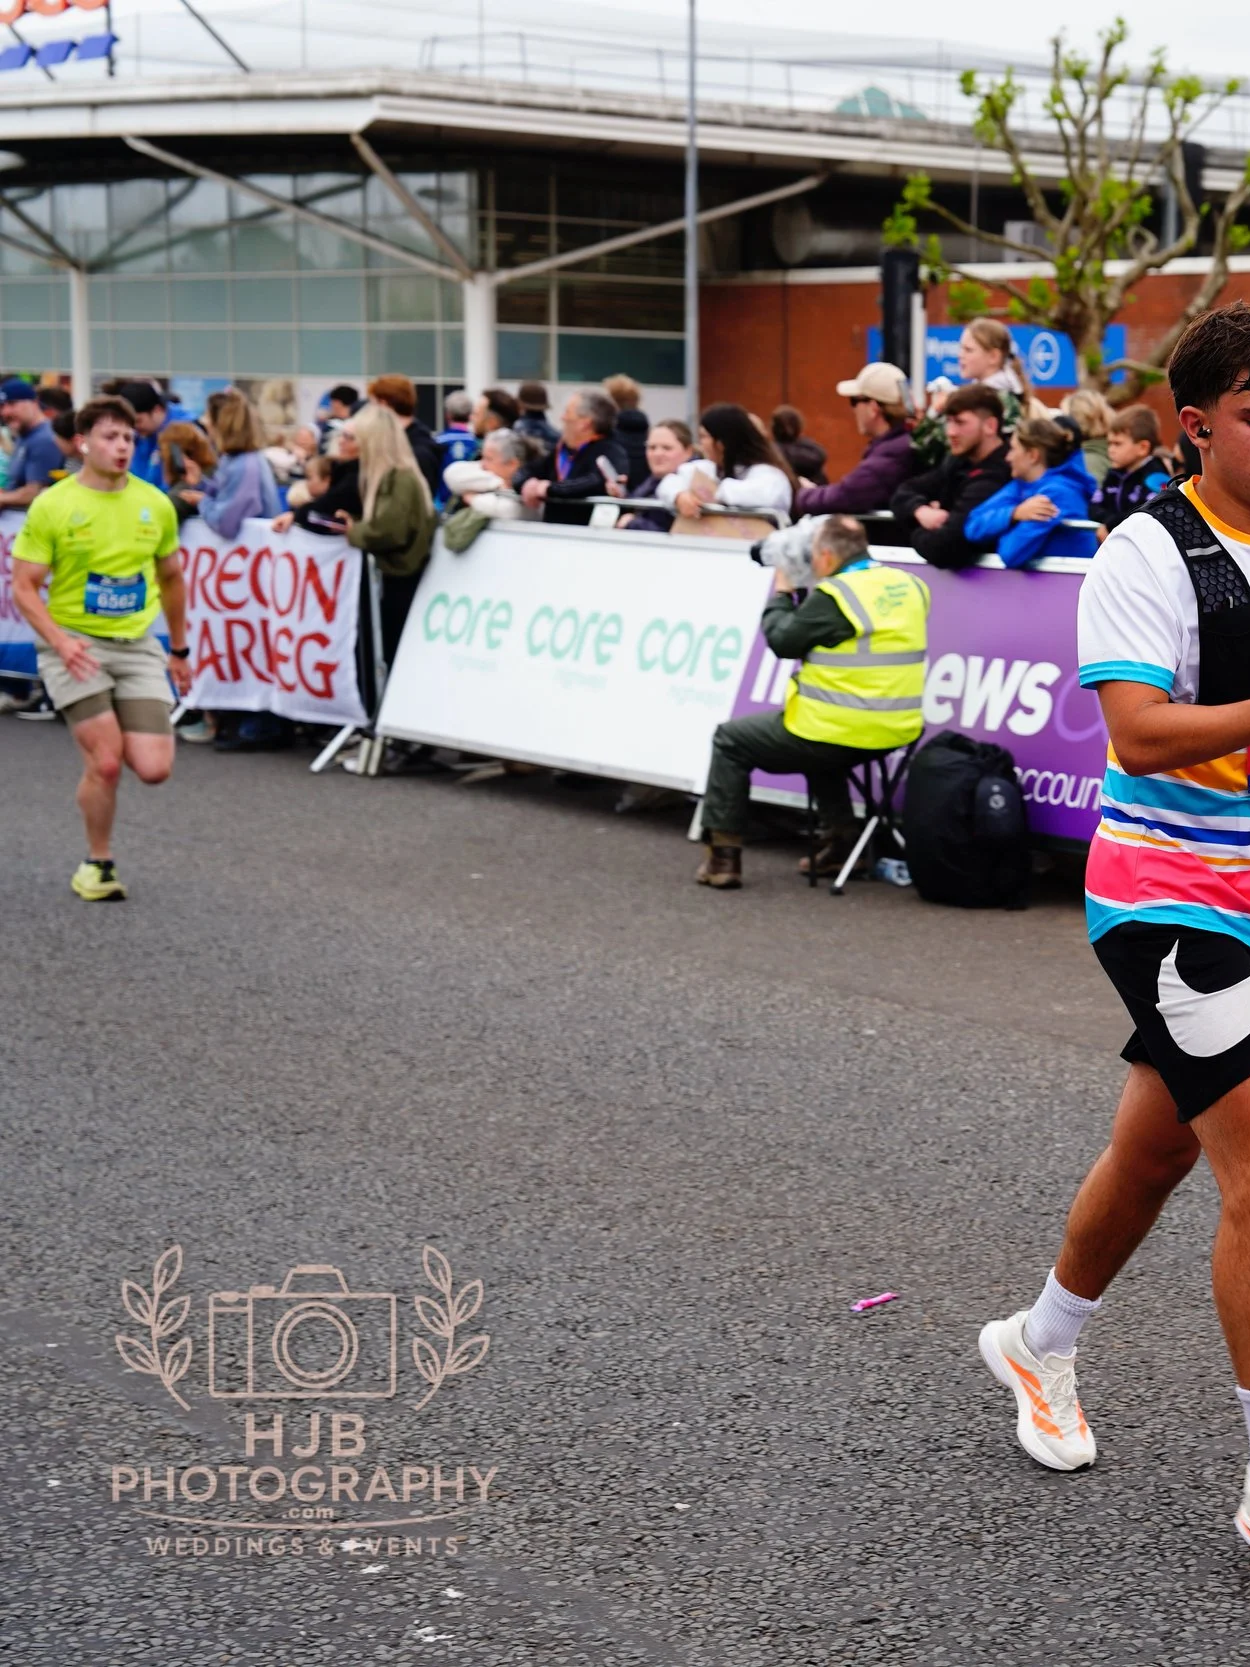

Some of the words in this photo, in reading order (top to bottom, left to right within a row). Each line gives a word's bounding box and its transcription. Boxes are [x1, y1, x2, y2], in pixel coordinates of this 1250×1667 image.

[185, 617, 340, 699] ARIEG
[422, 591, 513, 650] core
[526, 604, 623, 666] core
[636, 617, 743, 682] core
[922, 652, 1062, 736] ews
[1013, 766, 1104, 812] ccoun
